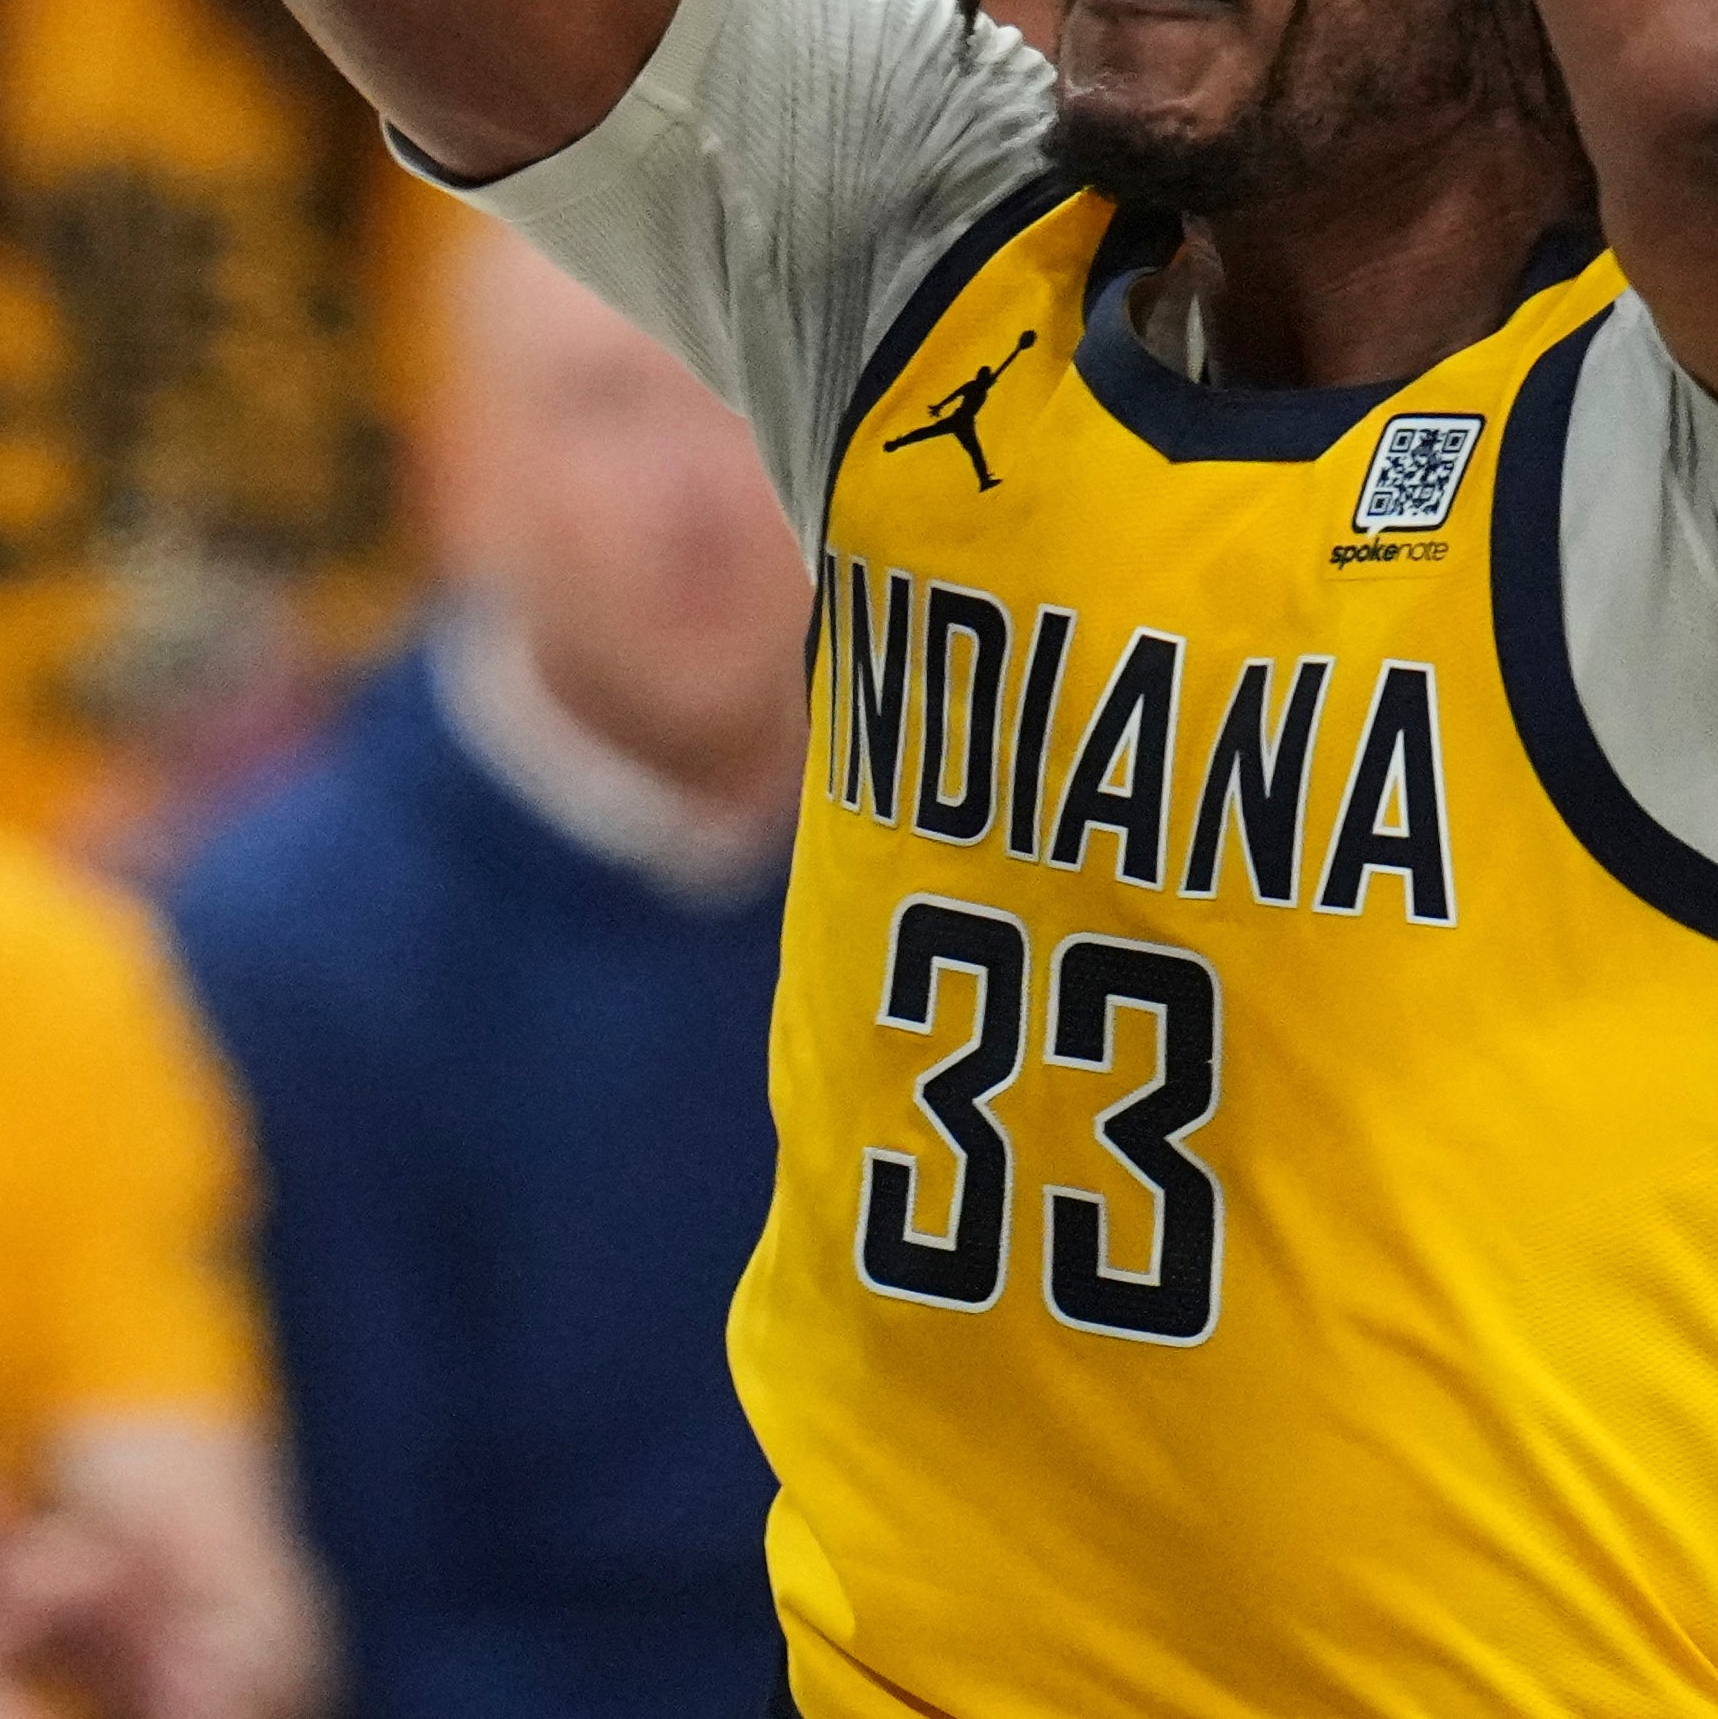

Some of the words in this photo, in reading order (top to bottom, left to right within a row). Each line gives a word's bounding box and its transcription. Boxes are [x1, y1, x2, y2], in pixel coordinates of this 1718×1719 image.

[824, 551, 1457, 928] INDIANA
[1330, 538, 1448, 569] spokenote
[855, 893, 1222, 1347] 33
